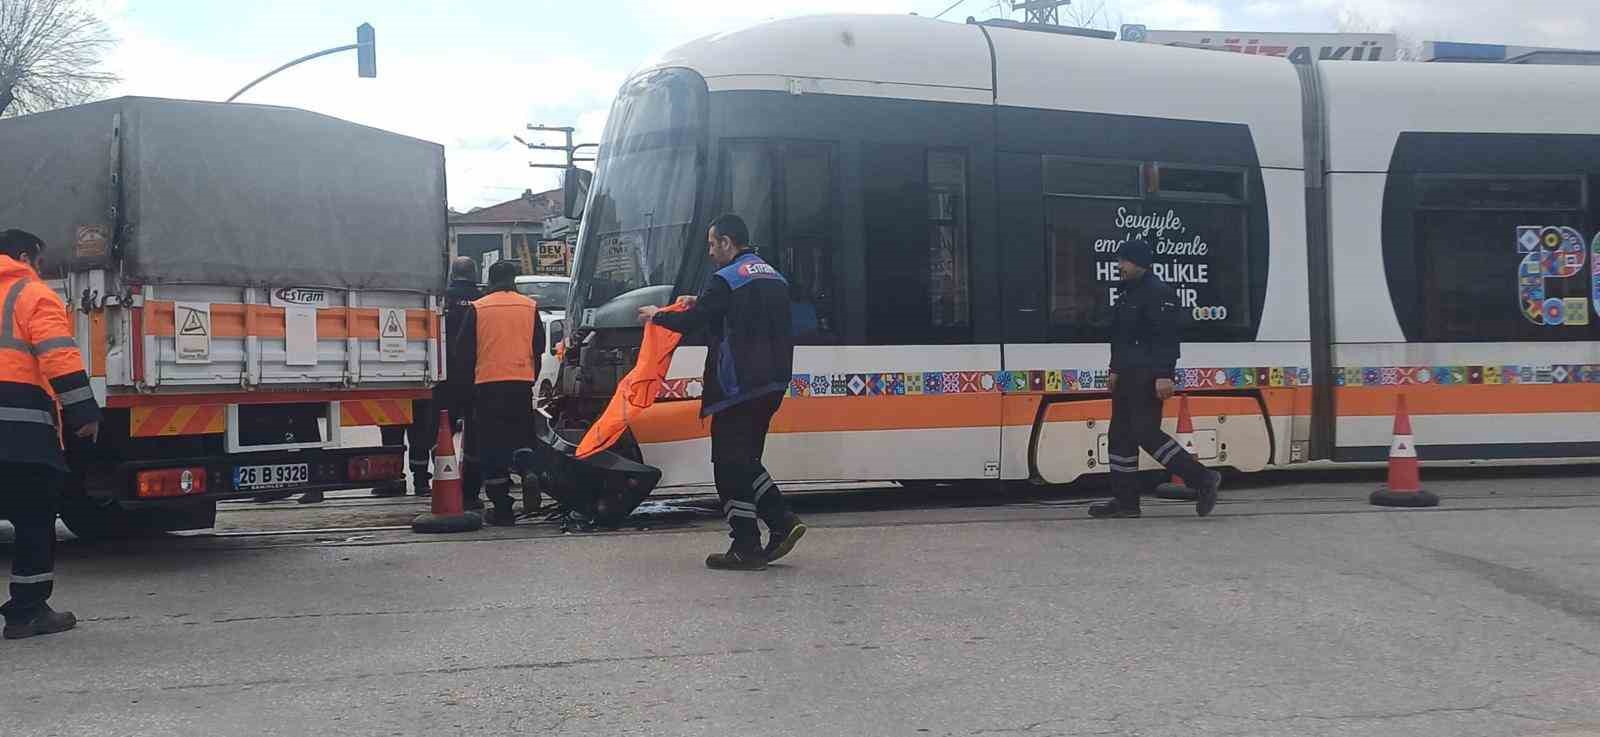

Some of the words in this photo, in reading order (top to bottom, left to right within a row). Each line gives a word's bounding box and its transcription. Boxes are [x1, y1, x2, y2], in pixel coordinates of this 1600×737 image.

[1115, 206, 1186, 237] Sevgiyle,
[1156, 236, 1208, 256] özenle
[240, 468, 257, 484] 26
[262, 467, 272, 482] B
[276, 465, 307, 482] 9328
